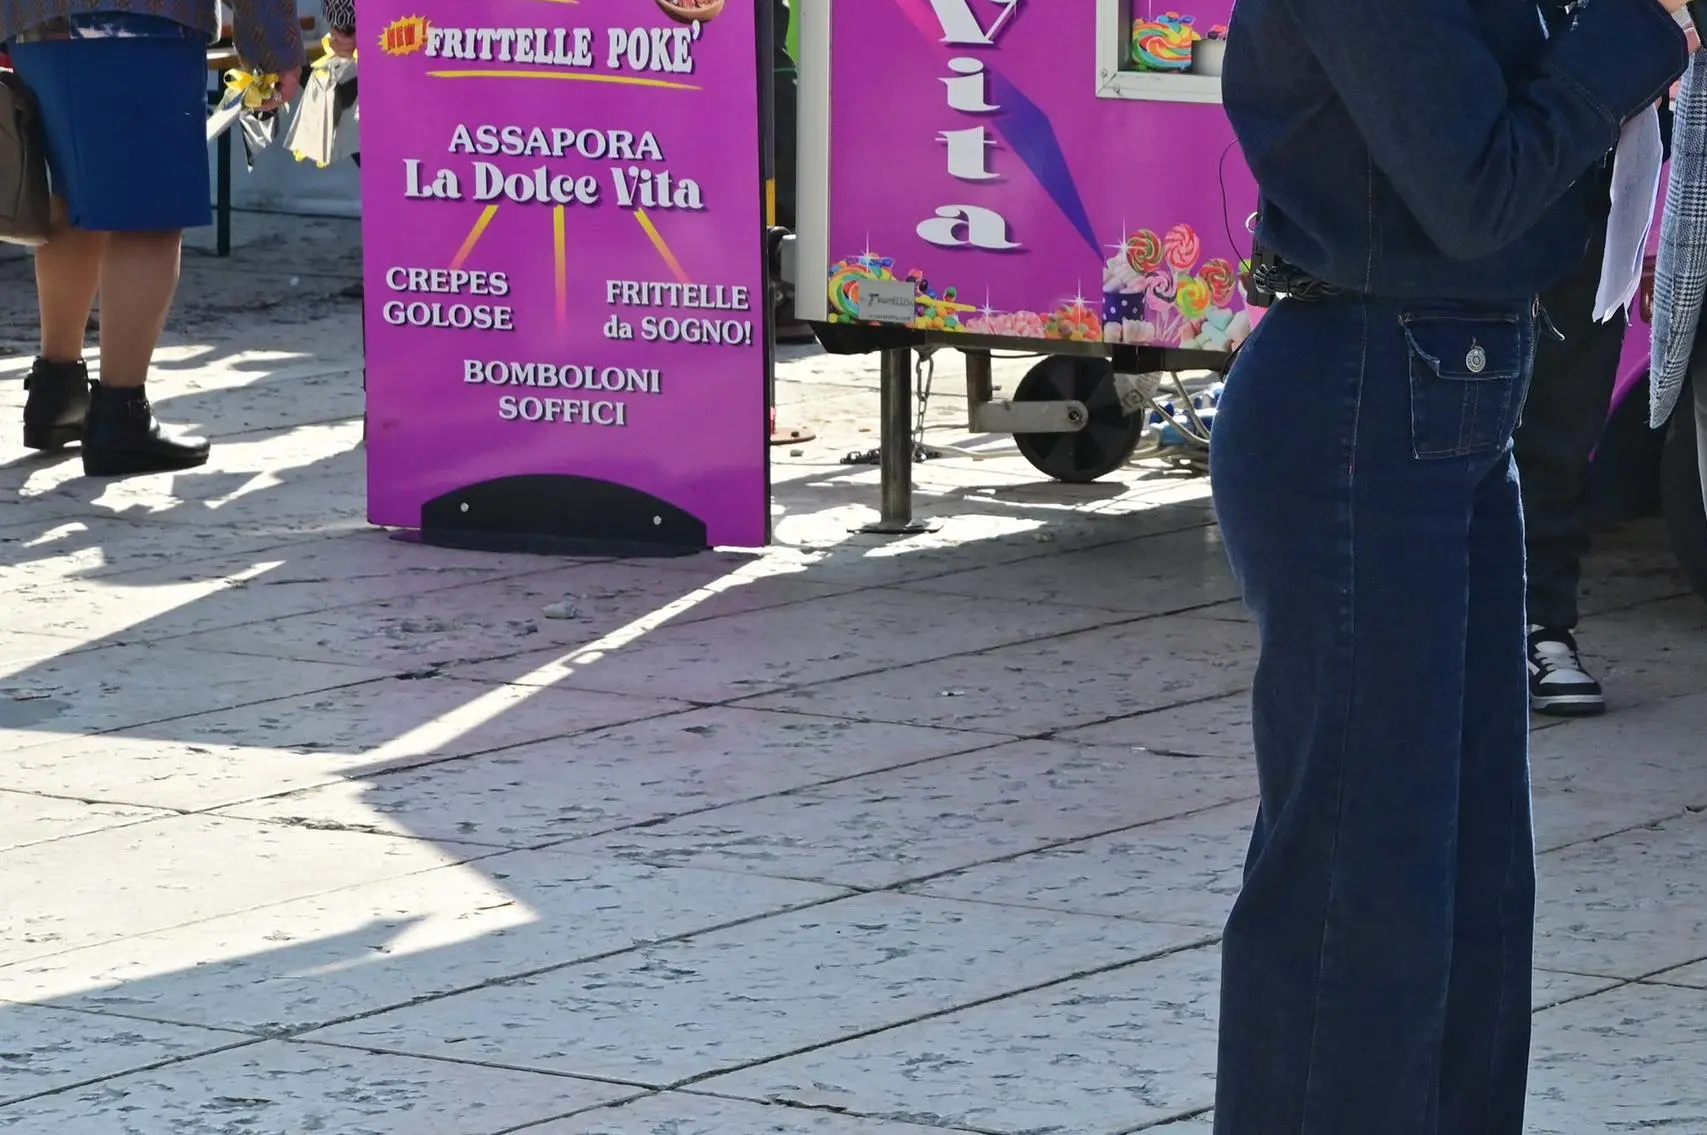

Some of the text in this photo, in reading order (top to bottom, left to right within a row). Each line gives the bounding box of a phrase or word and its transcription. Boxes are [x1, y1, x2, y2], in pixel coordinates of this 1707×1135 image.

[425, 27, 592, 67] FRITTELLE
[448, 123, 663, 161] ASSAPORA
[403, 158, 704, 209] La Dolce Vita
[385, 267, 509, 296] CREPES
[606, 279, 750, 311] FRITTELLE
[383, 301, 514, 331] GOLOSE
[603, 314, 753, 345] da SOGNO!
[463, 360, 661, 394] BOMBOLONI
[498, 395, 626, 426] SOFFICI
